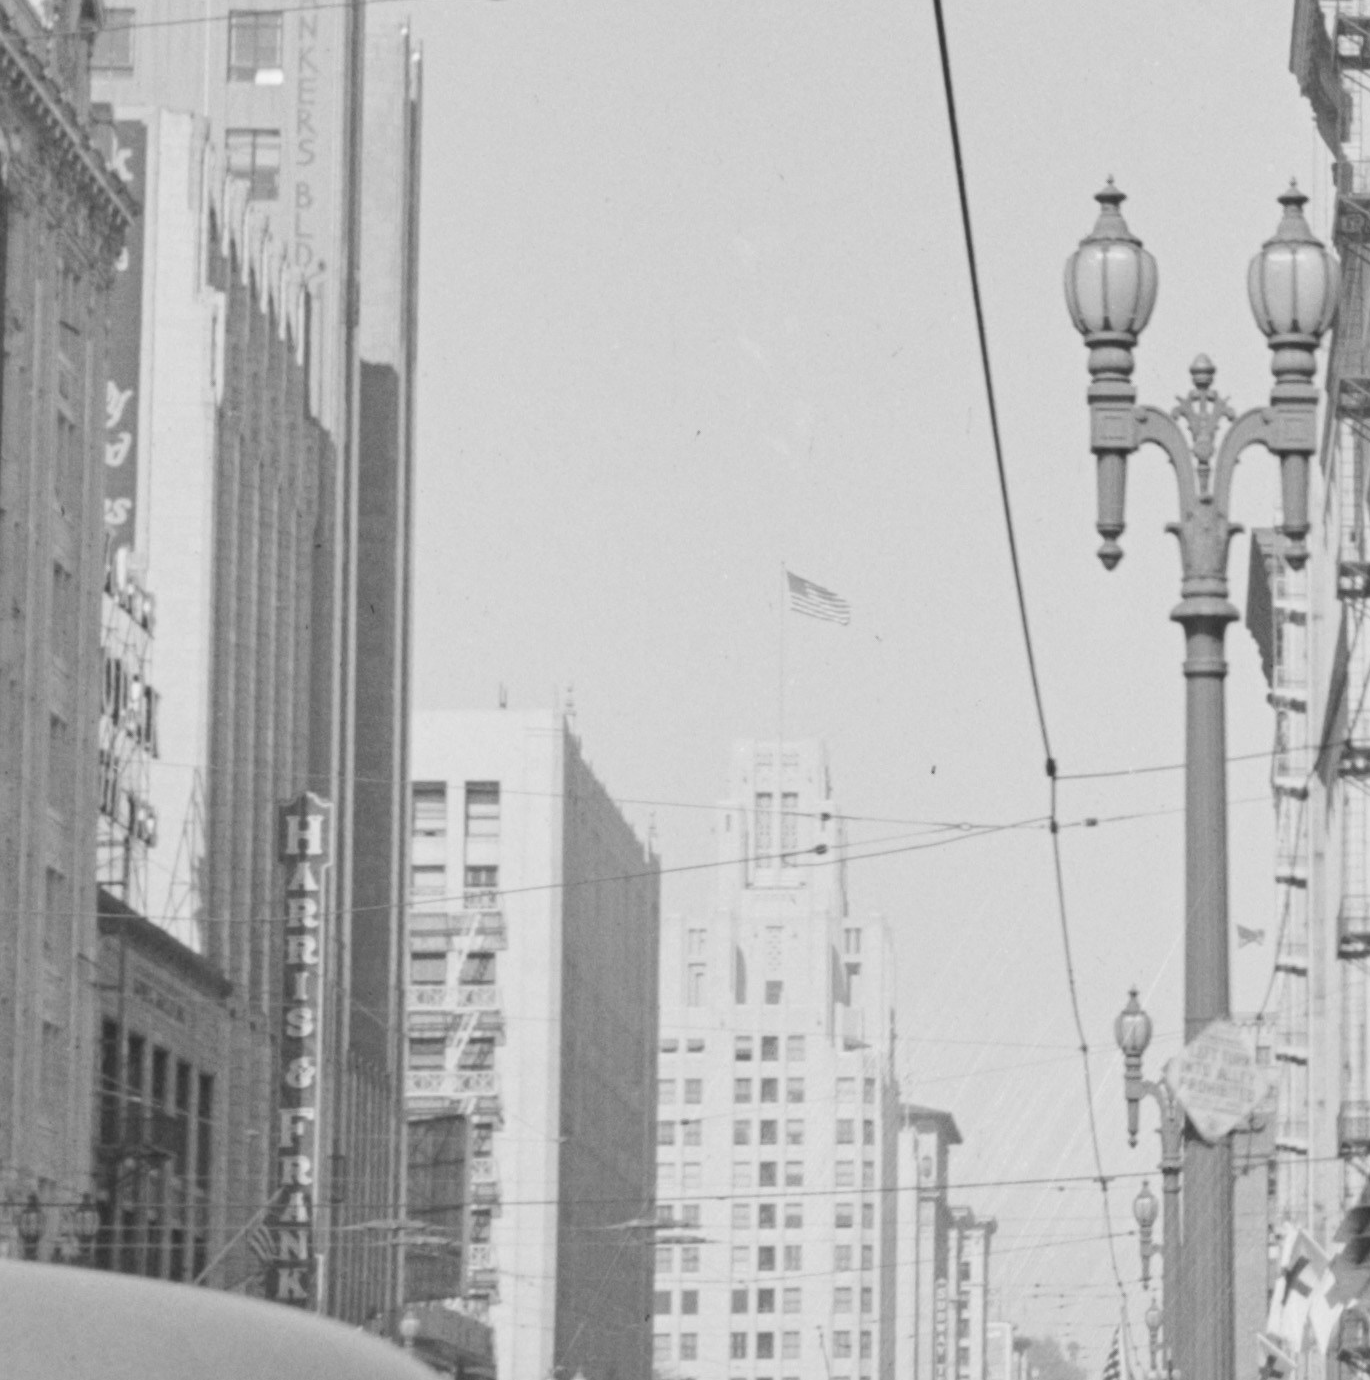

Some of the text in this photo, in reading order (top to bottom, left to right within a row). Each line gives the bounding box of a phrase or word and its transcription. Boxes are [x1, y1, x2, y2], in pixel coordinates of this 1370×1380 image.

[294, 180, 315, 281] BLD
[278, 814, 323, 1299] HARRIS & FRANK
